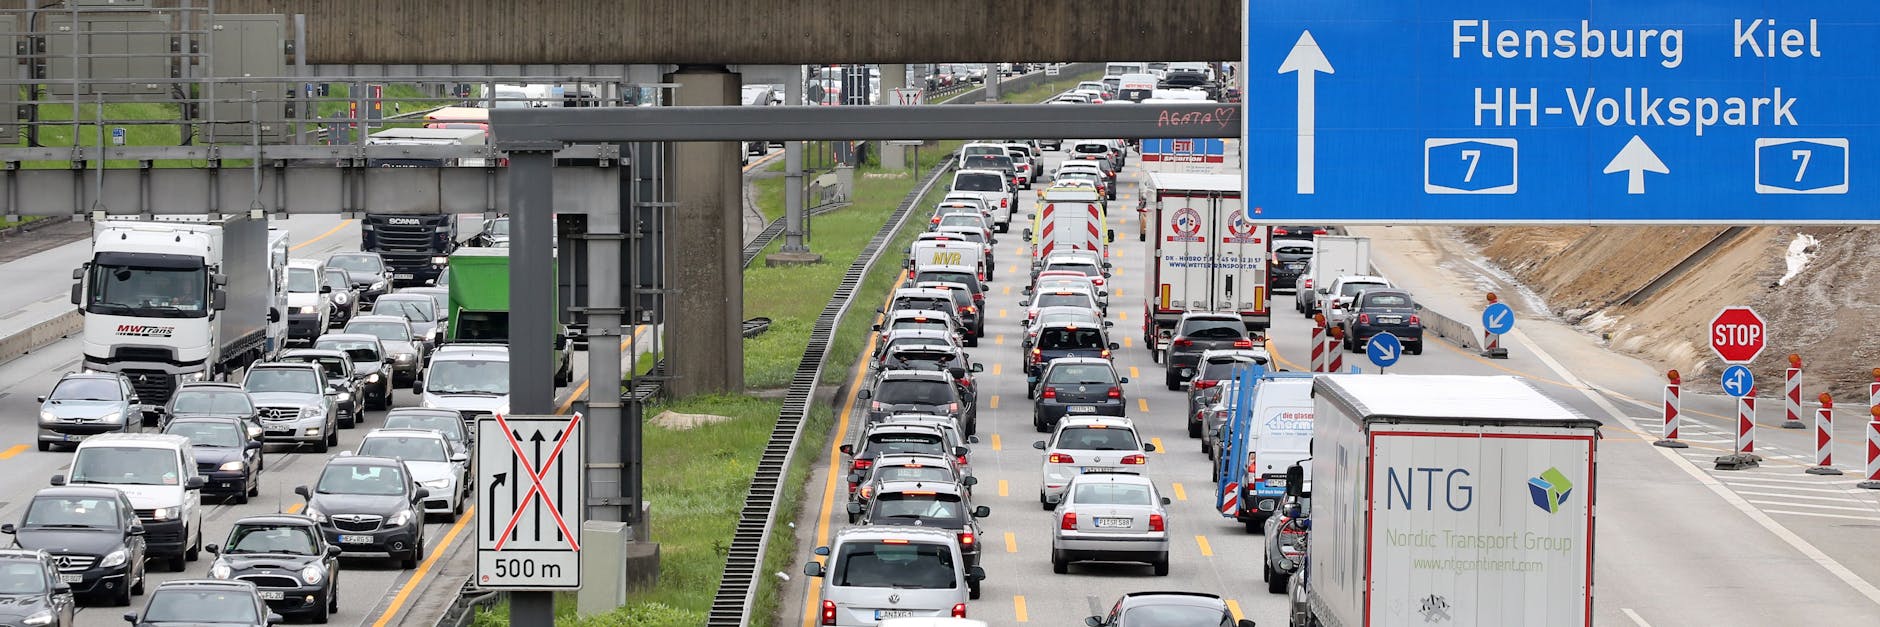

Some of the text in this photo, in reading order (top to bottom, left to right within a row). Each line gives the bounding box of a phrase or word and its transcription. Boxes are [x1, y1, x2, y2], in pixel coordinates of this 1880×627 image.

[1453, 18, 1821, 69] Flensburg Kiel
[1158, 109, 1212, 128] AGATA
[1474, 87, 1798, 137] HH-Volkspark
[1461, 150, 1481, 182] 7
[1792, 150, 1812, 182] 7
[932, 251, 961, 265] NVR
[117, 324, 173, 335] MWTrans
[1715, 324, 1761, 346] STOP
[1282, 411, 1293, 419] die
[1386, 466, 1473, 512] NTG
[1386, 527, 1572, 555] Nordic Transport Group
[495, 558, 561, 578] 500 m
[1413, 556, 1544, 575] www.ntgcontinent.com
